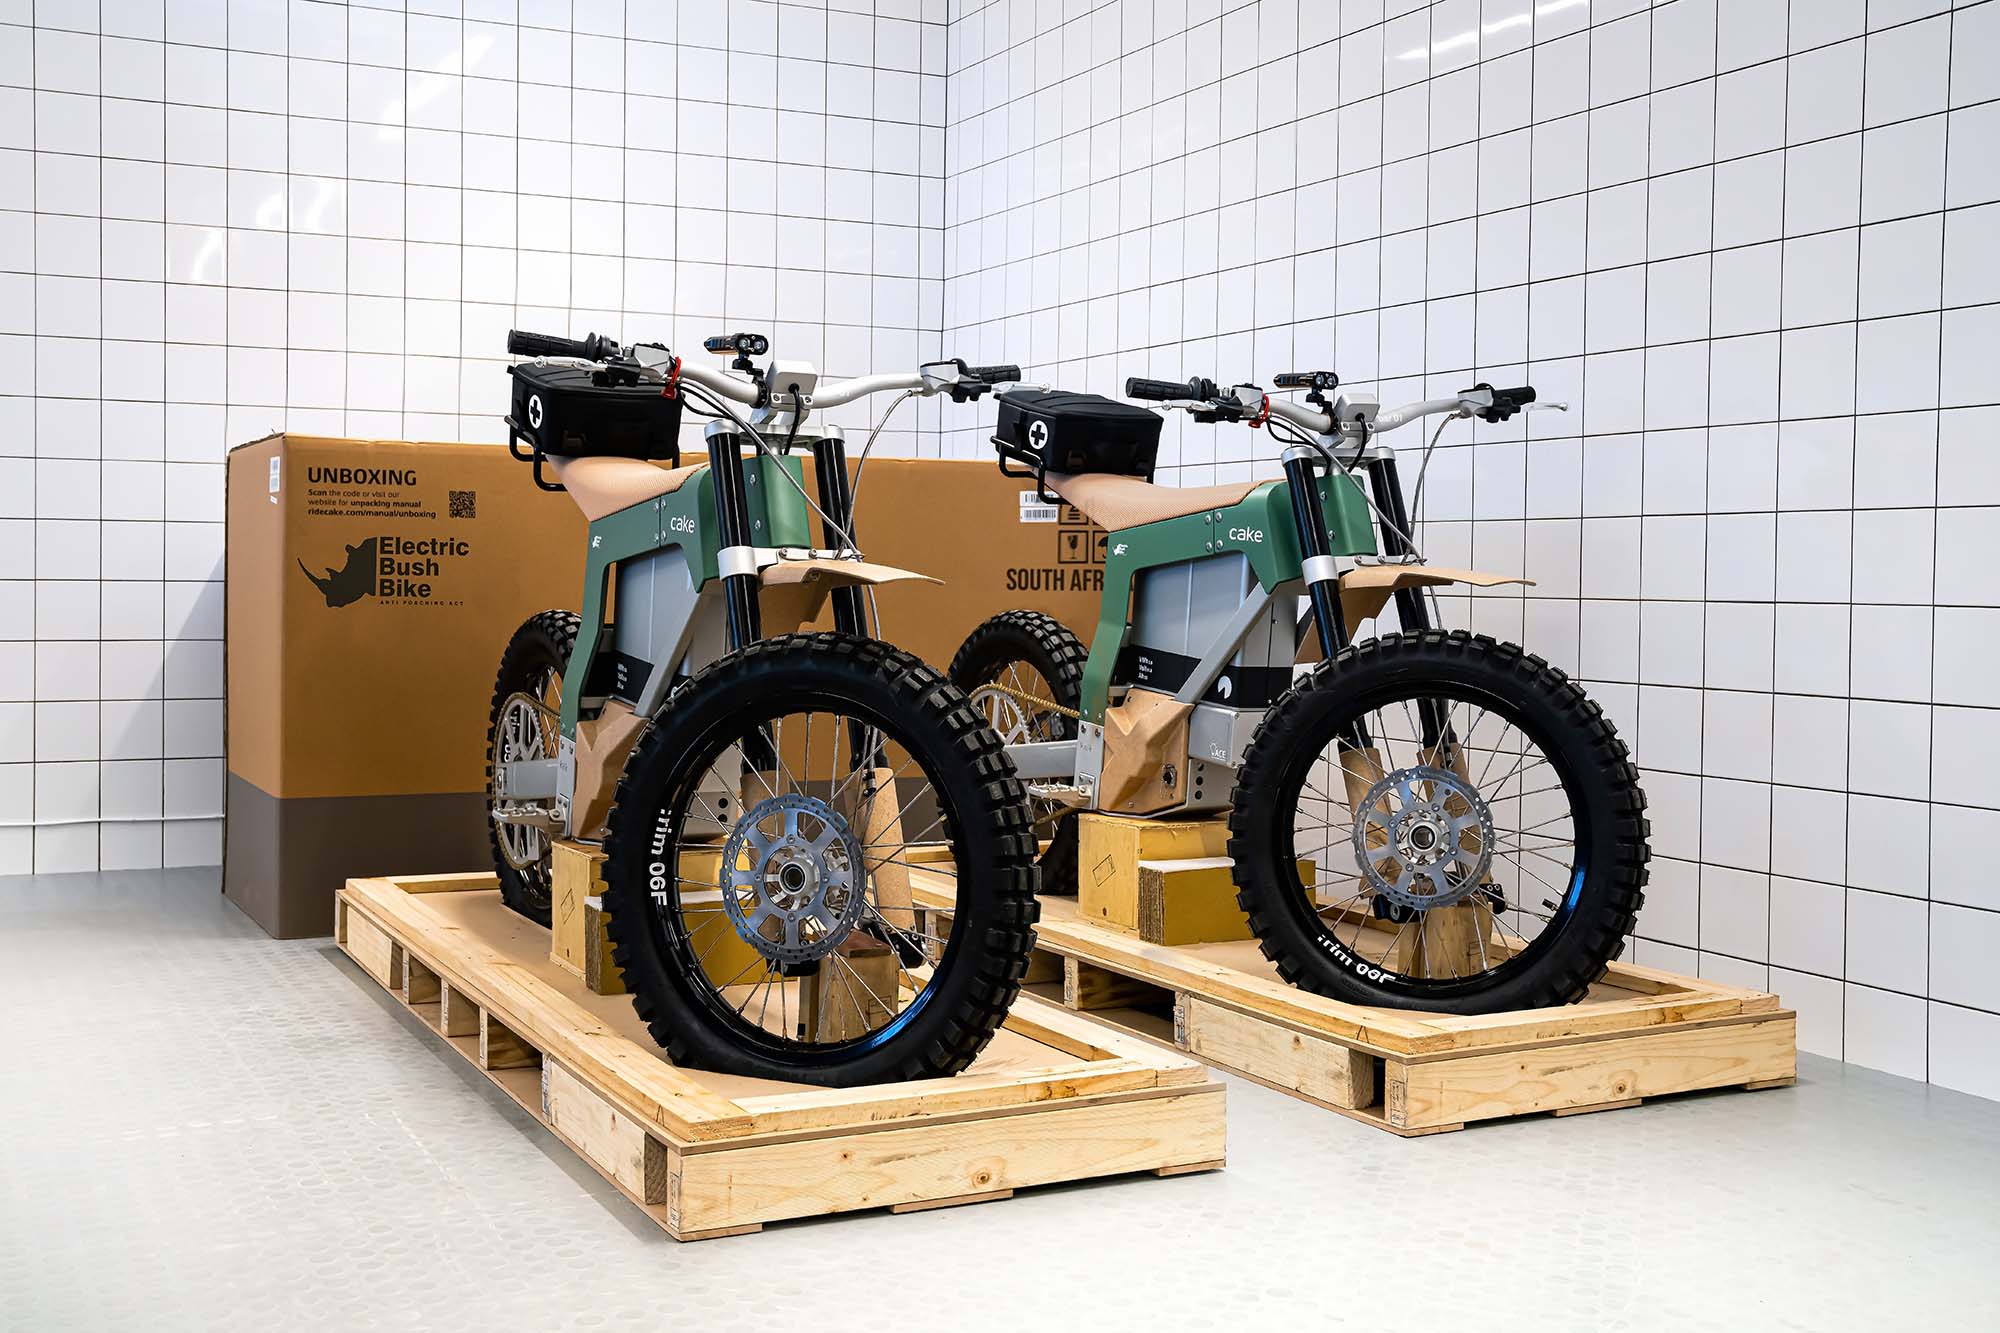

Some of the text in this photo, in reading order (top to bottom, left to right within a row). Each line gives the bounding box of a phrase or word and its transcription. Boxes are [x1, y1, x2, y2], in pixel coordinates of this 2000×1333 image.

[308, 466, 417, 486] UNBOXING
[308, 498, 336, 506] website
[350, 500, 391, 508] unpacking
[392, 500, 422, 508] manual
[329, 489, 341, 497] the
[342, 490, 361, 498] code
[371, 490, 386, 498] visit
[308, 508, 437, 519] ridecake.com/manual/unboxing
[670, 515, 695, 534] cake
[1228, 526, 1264, 543] cake
[379, 536, 470, 556] Electric
[379, 557, 440, 576] Bush
[379, 578, 432, 598] Bike
[1006, 568, 1065, 591] SOUTH
[649, 862, 668, 906] 06F
